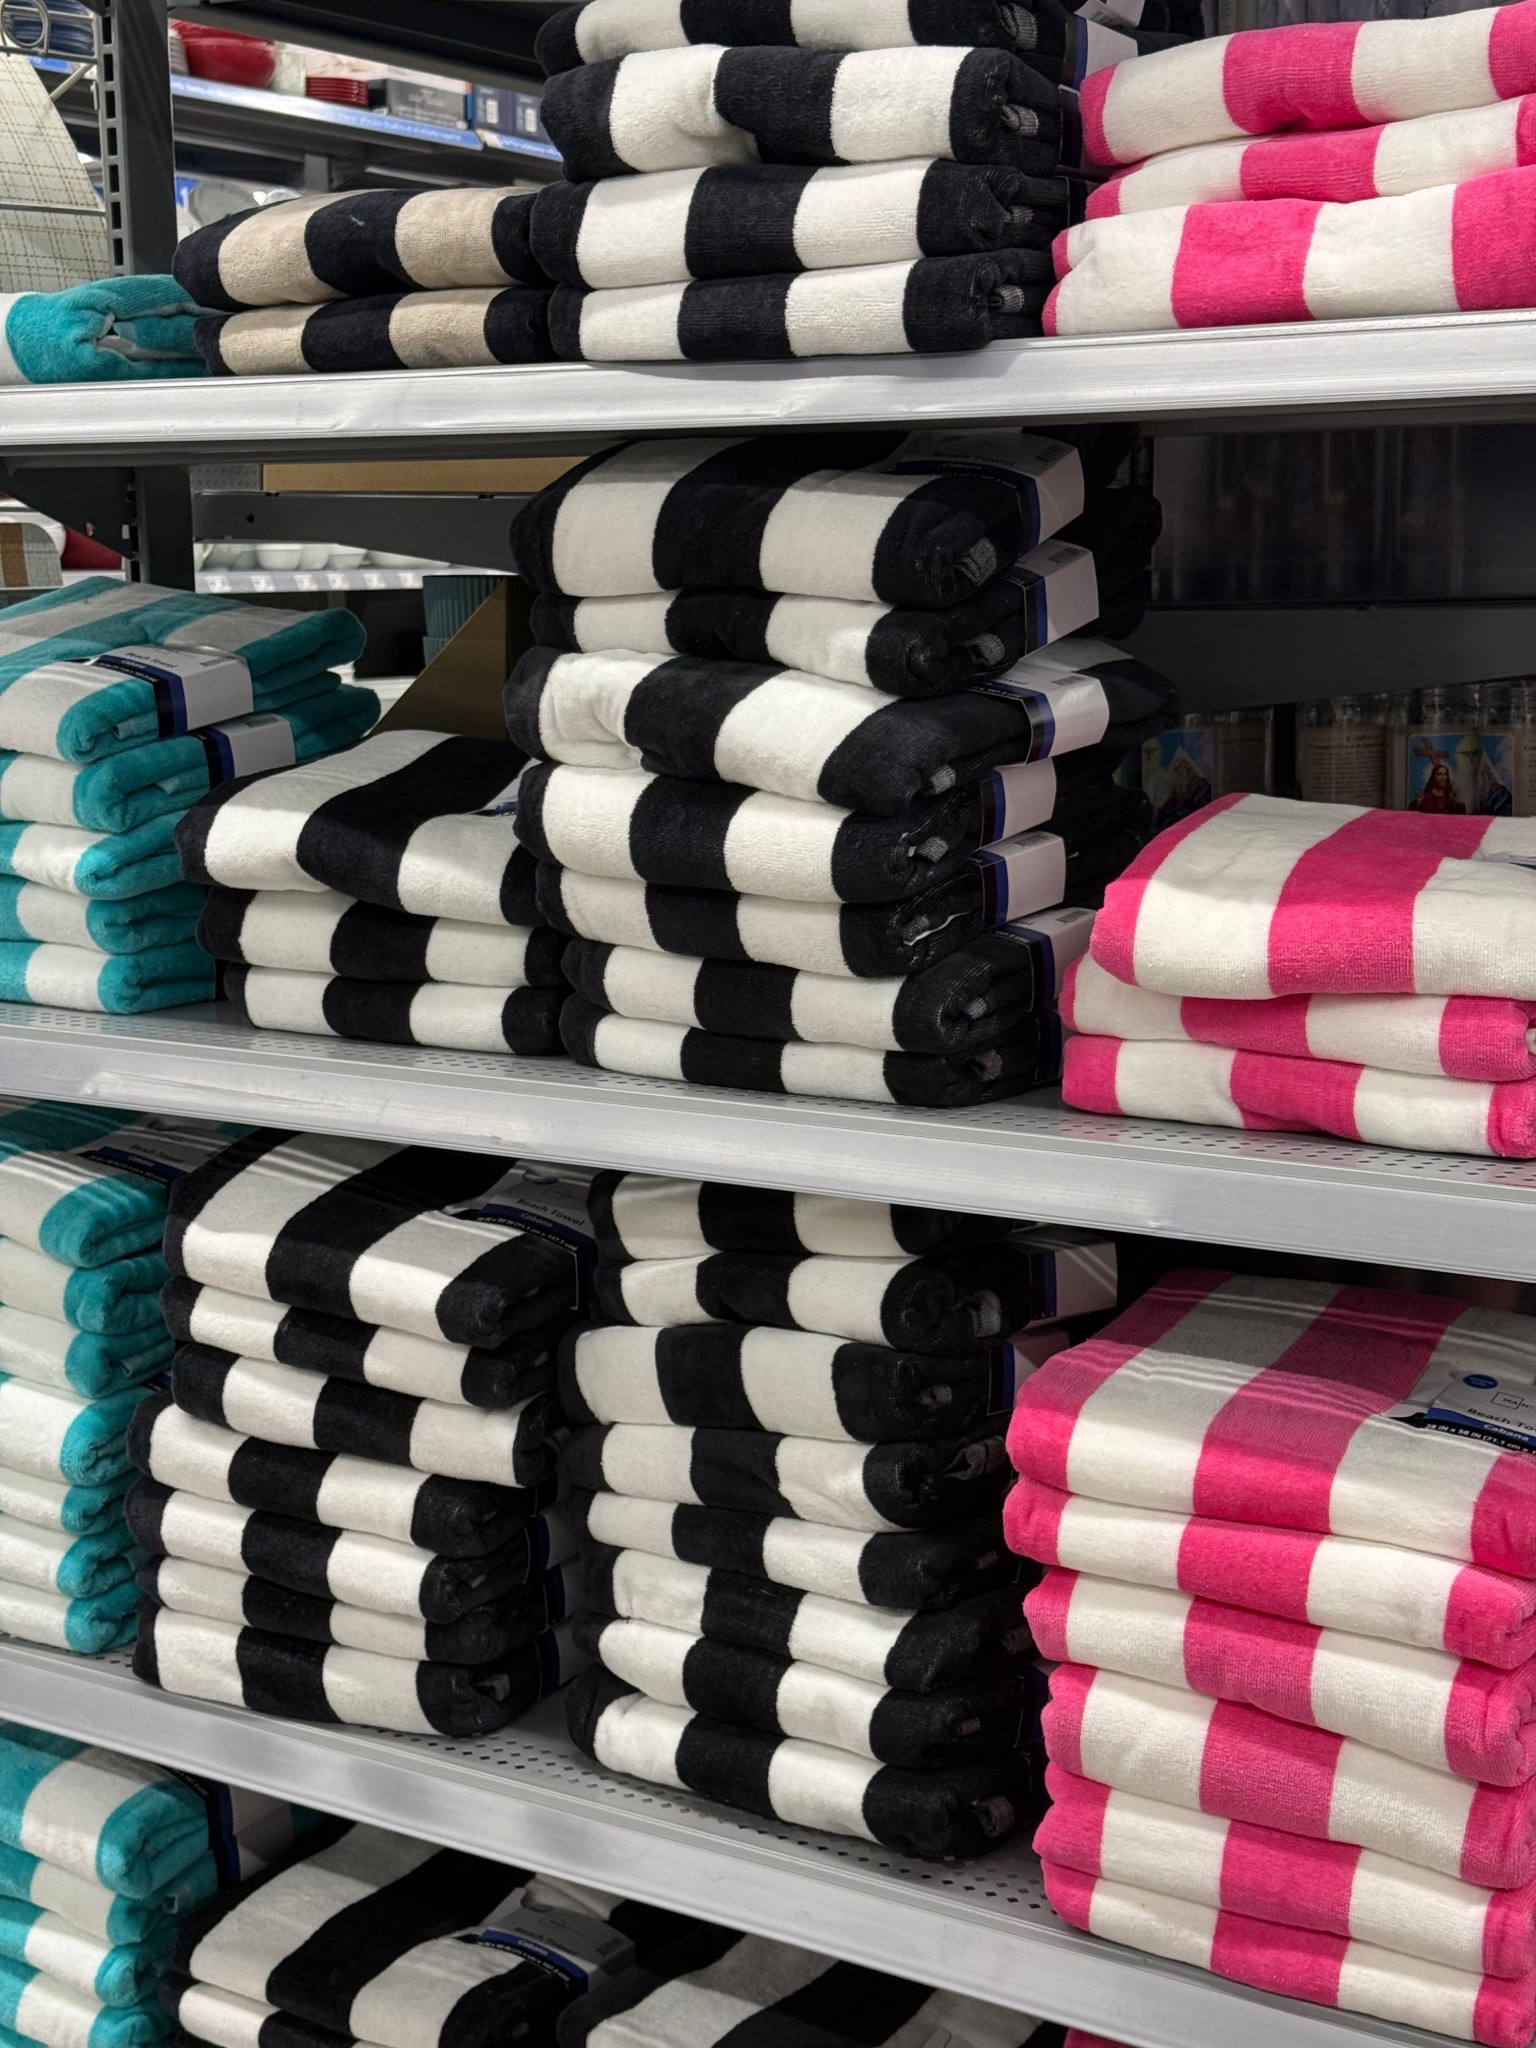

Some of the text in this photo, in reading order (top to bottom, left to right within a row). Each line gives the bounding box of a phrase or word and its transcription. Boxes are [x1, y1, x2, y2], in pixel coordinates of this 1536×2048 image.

[516, 1198, 586, 1227] Beach Towel
[520, 1212, 554, 1228] Cabana
[1467, 1408, 1536, 1434] Beach To
[1483, 1423, 1530, 1442] Cabana
[1457, 1428, 1470, 1436] 58
[1470, 1430, 1482, 1439] IN
[1482, 1433, 1506, 1447] (71.1
[1506, 1441, 1521, 1451] cm
